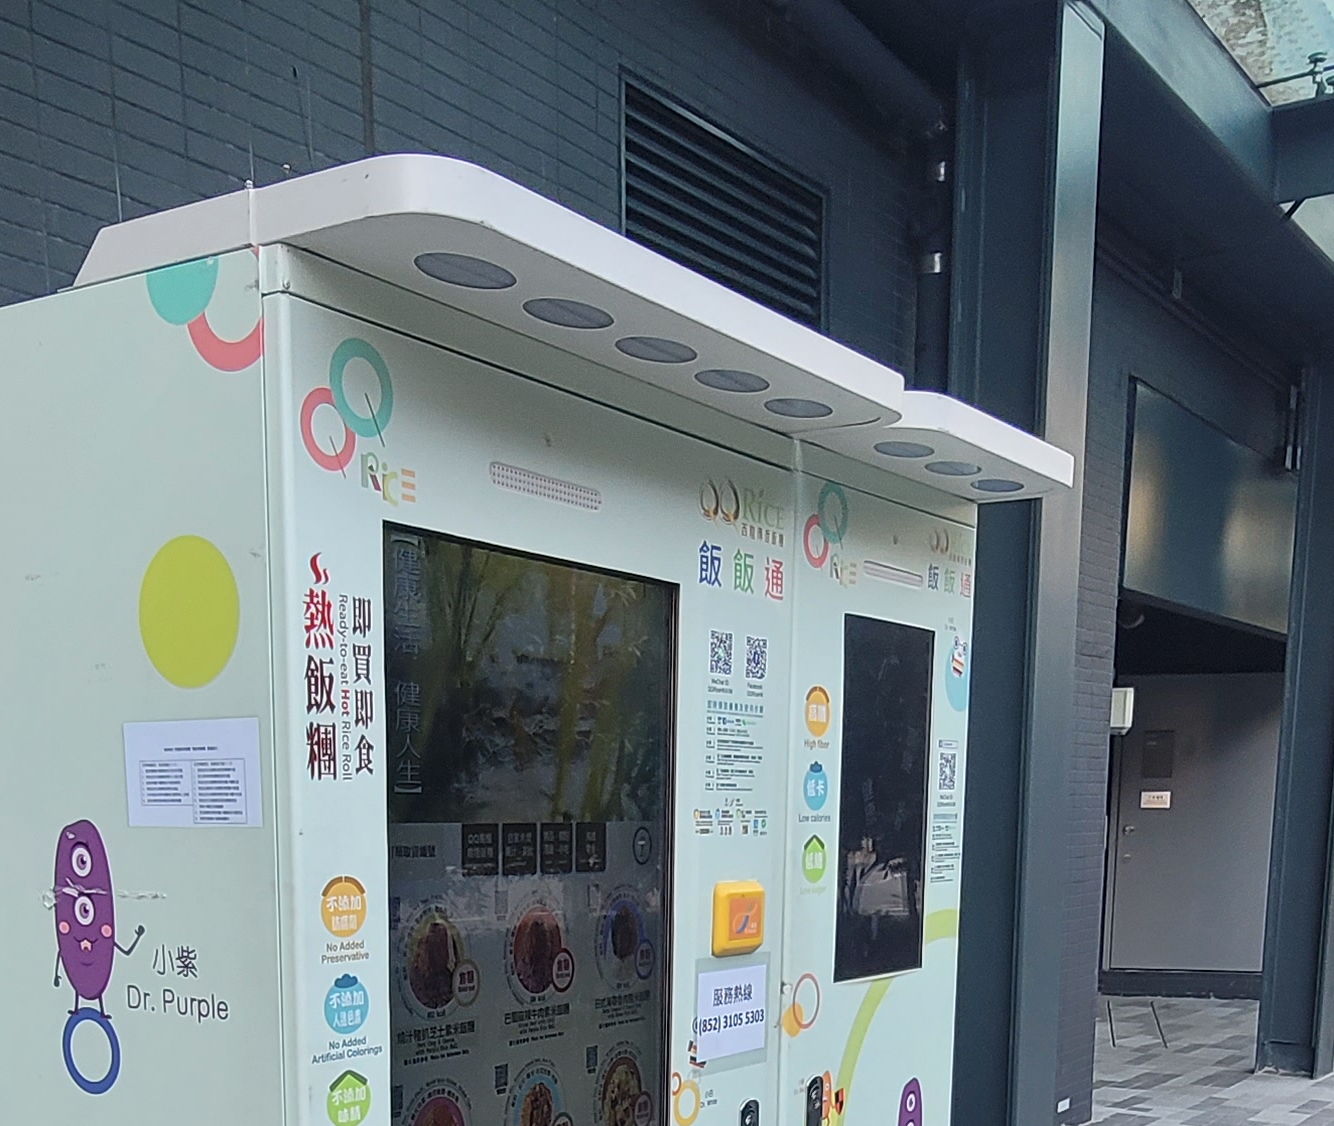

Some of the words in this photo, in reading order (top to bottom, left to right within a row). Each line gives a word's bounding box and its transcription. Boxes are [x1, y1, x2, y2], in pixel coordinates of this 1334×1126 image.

[698, 540, 784, 601] 飯飯通
[338, 593, 350, 686] Ready-to-eat
[303, 587, 337, 782] 熱飯糰
[352, 595, 374, 776] 即買即食
[341, 689, 351, 717] Hot
[341, 721, 352, 751] Rice
[342, 754, 353, 781] Roll
[326, 895, 362, 913] 不添加
[321, 950, 370, 965] Preservative
[326, 942, 338, 953] No
[339, 939, 365, 951] Added
[152, 943, 198, 978] 小紫
[127, 984, 156, 1012] Dr.
[162, 988, 229, 1024] Purple
[329, 991, 365, 1009] 不添加
[712, 982, 753, 1008] 服務熱線
[698, 1013, 722, 1037] (852)
[723, 1011, 744, 1029] 3105
[745, 1008, 765, 1025] 5303
[311, 1050, 346, 1065] Artificial
[346, 1045, 383, 1060] Colorings
[328, 1040, 341, 1051] No
[341, 1035, 367, 1048] Added
